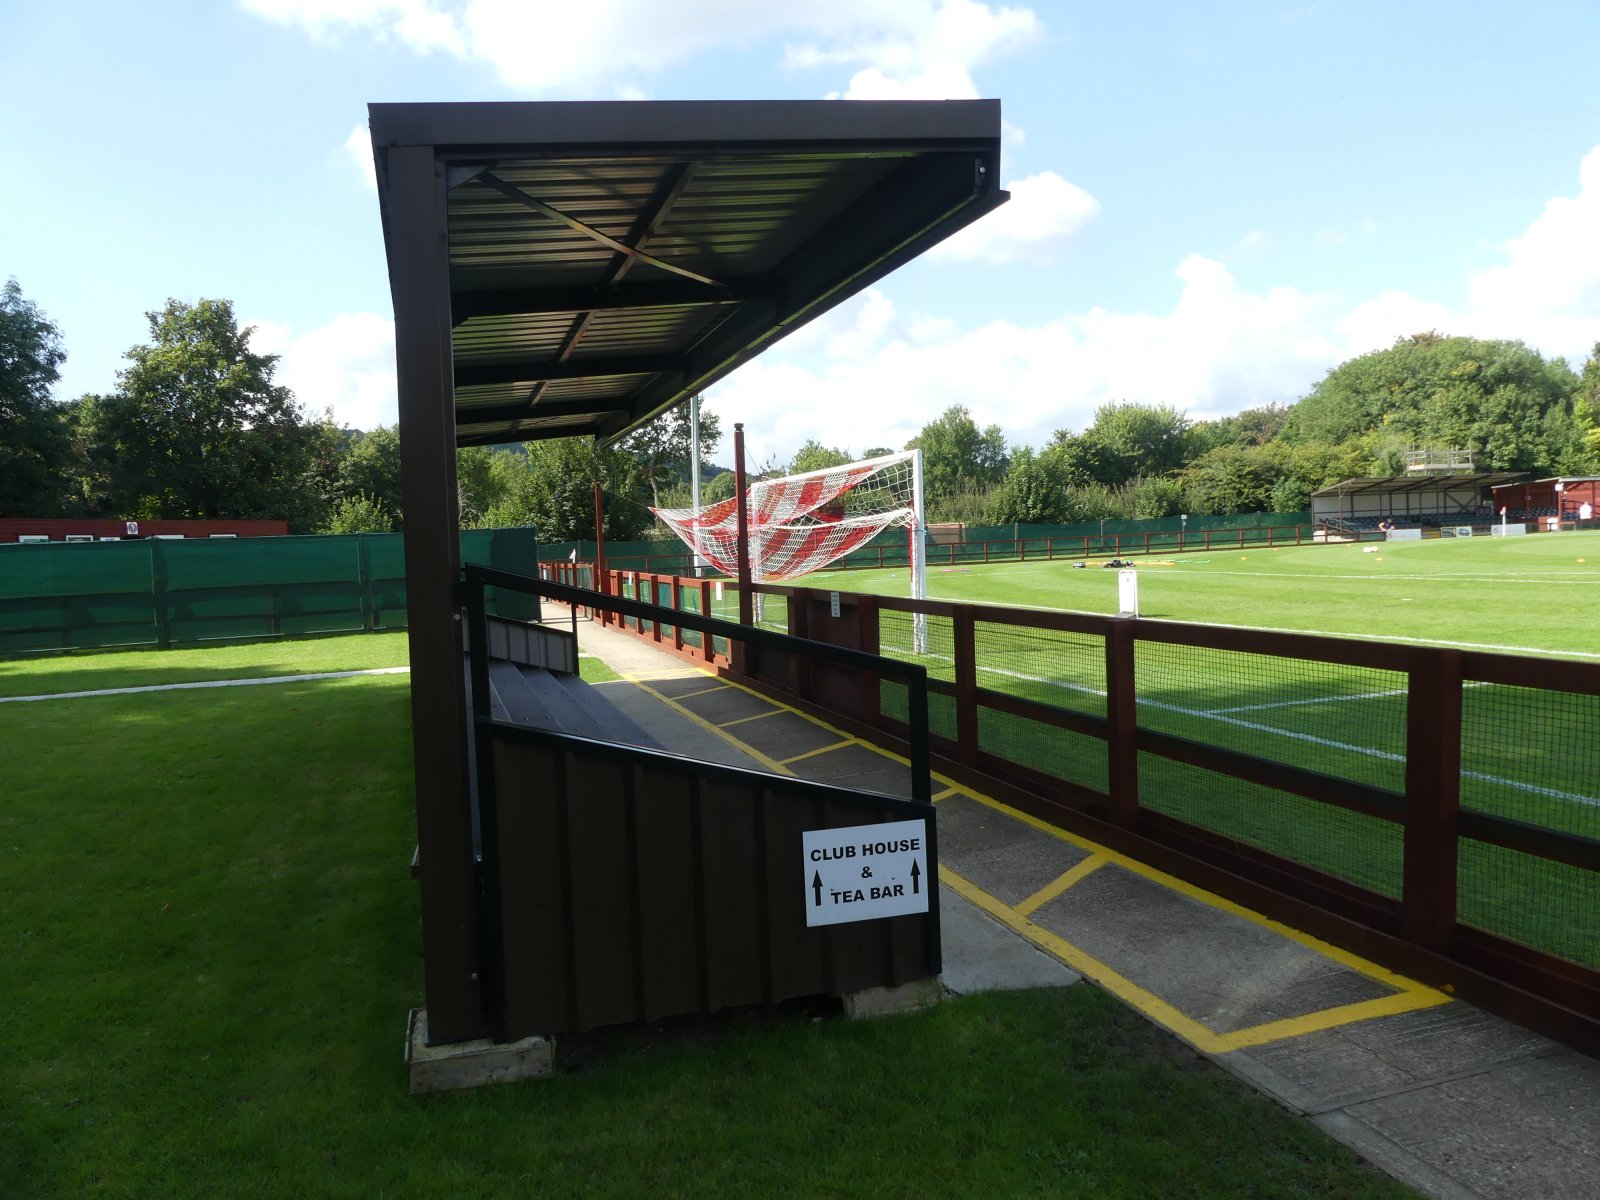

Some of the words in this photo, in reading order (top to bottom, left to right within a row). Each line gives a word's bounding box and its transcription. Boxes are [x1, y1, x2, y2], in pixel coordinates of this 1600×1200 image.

[810, 845, 857, 862] CLUB
[862, 838, 920, 857] HOUSE
[861, 866, 873, 878] &
[831, 889, 865, 904] TEA
[870, 884, 904, 900] BAR
